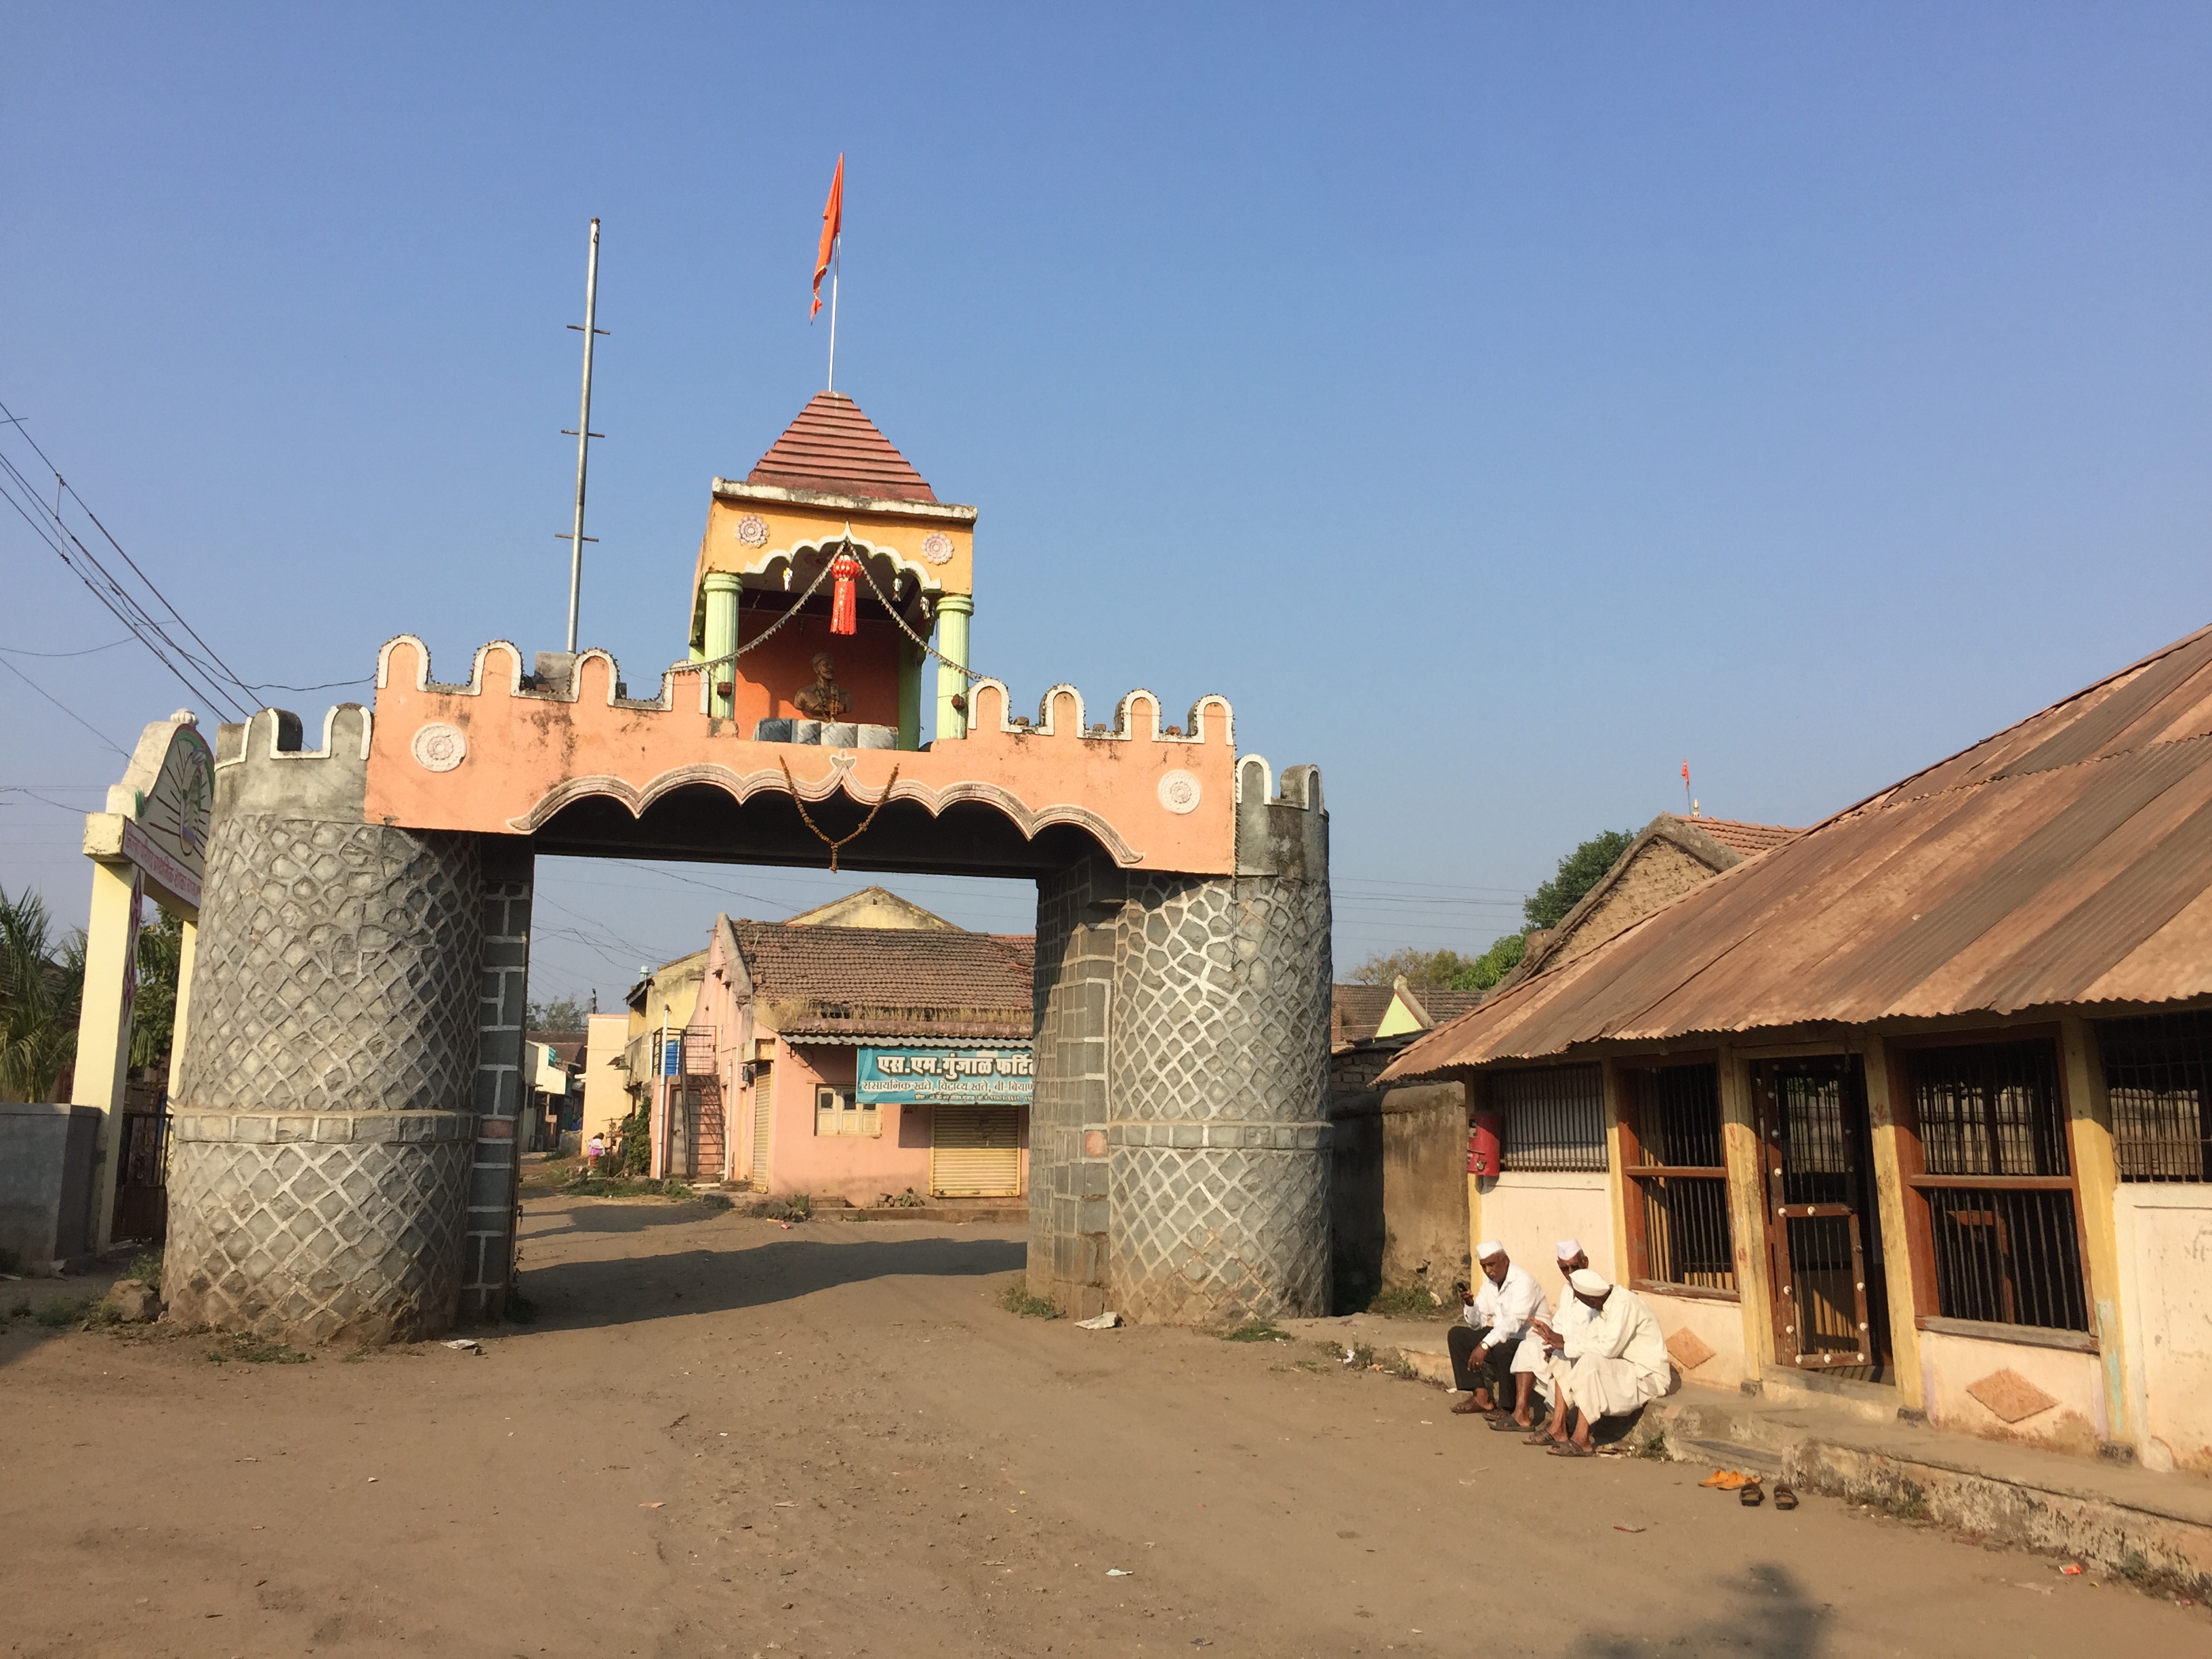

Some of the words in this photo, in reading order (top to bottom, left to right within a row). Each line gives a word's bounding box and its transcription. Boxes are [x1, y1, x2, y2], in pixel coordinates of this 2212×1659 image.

[863, 1079, 911, 1090] रासायनिक
[914, 1079, 935, 1092] खते,
[938, 1080, 968, 1091] विद्राव्य
[971, 1080, 991, 1092] खते,
